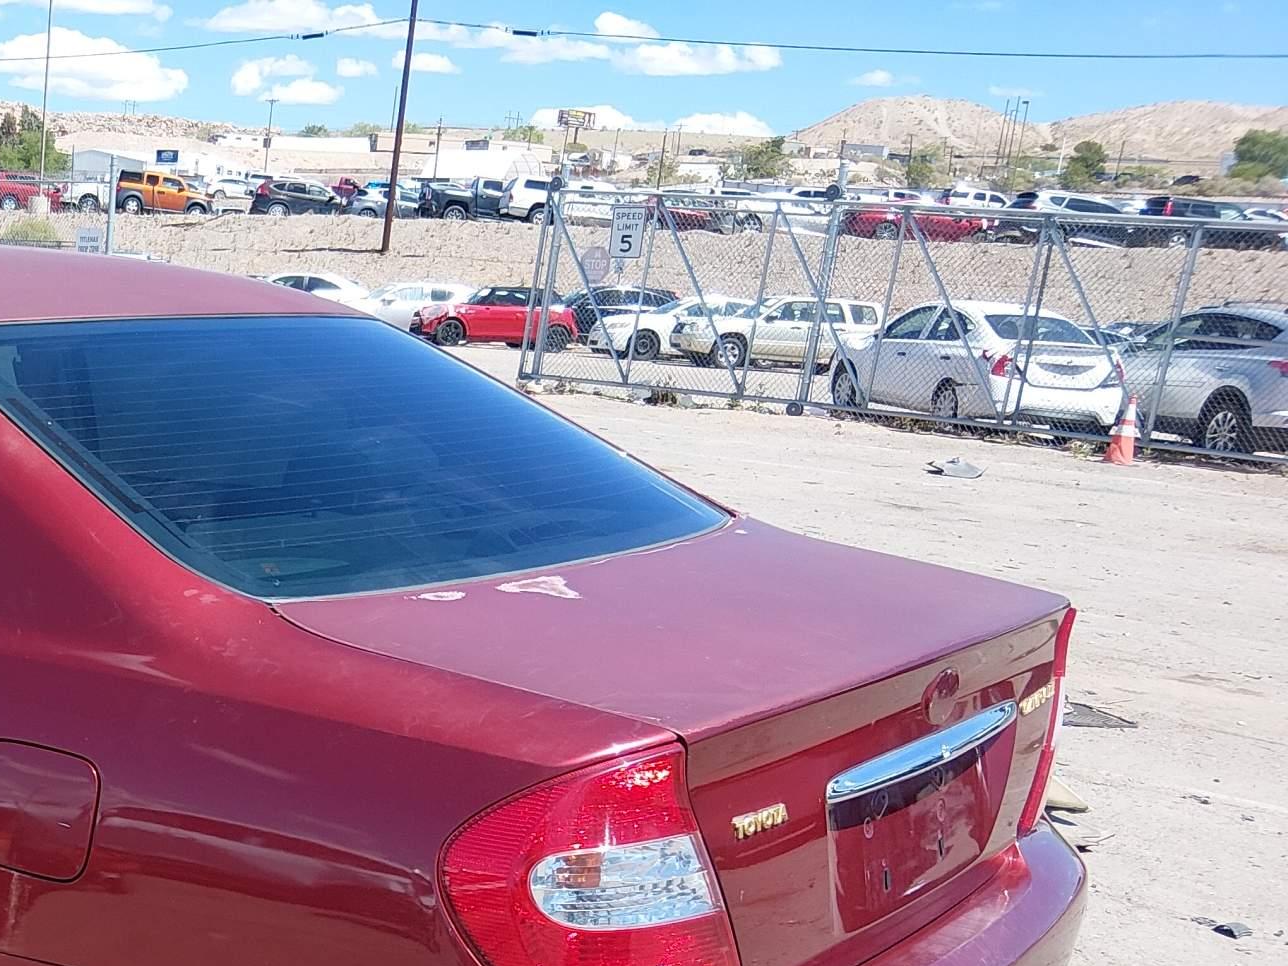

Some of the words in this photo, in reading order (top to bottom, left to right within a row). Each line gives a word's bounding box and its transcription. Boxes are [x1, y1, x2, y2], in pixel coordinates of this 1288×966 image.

[615, 212, 644, 221] SPEED
[617, 223, 640, 232] LIMIT
[619, 234, 633, 254] 5
[585, 259, 607, 270] STOP
[730, 802, 789, 840] TOYOTA
